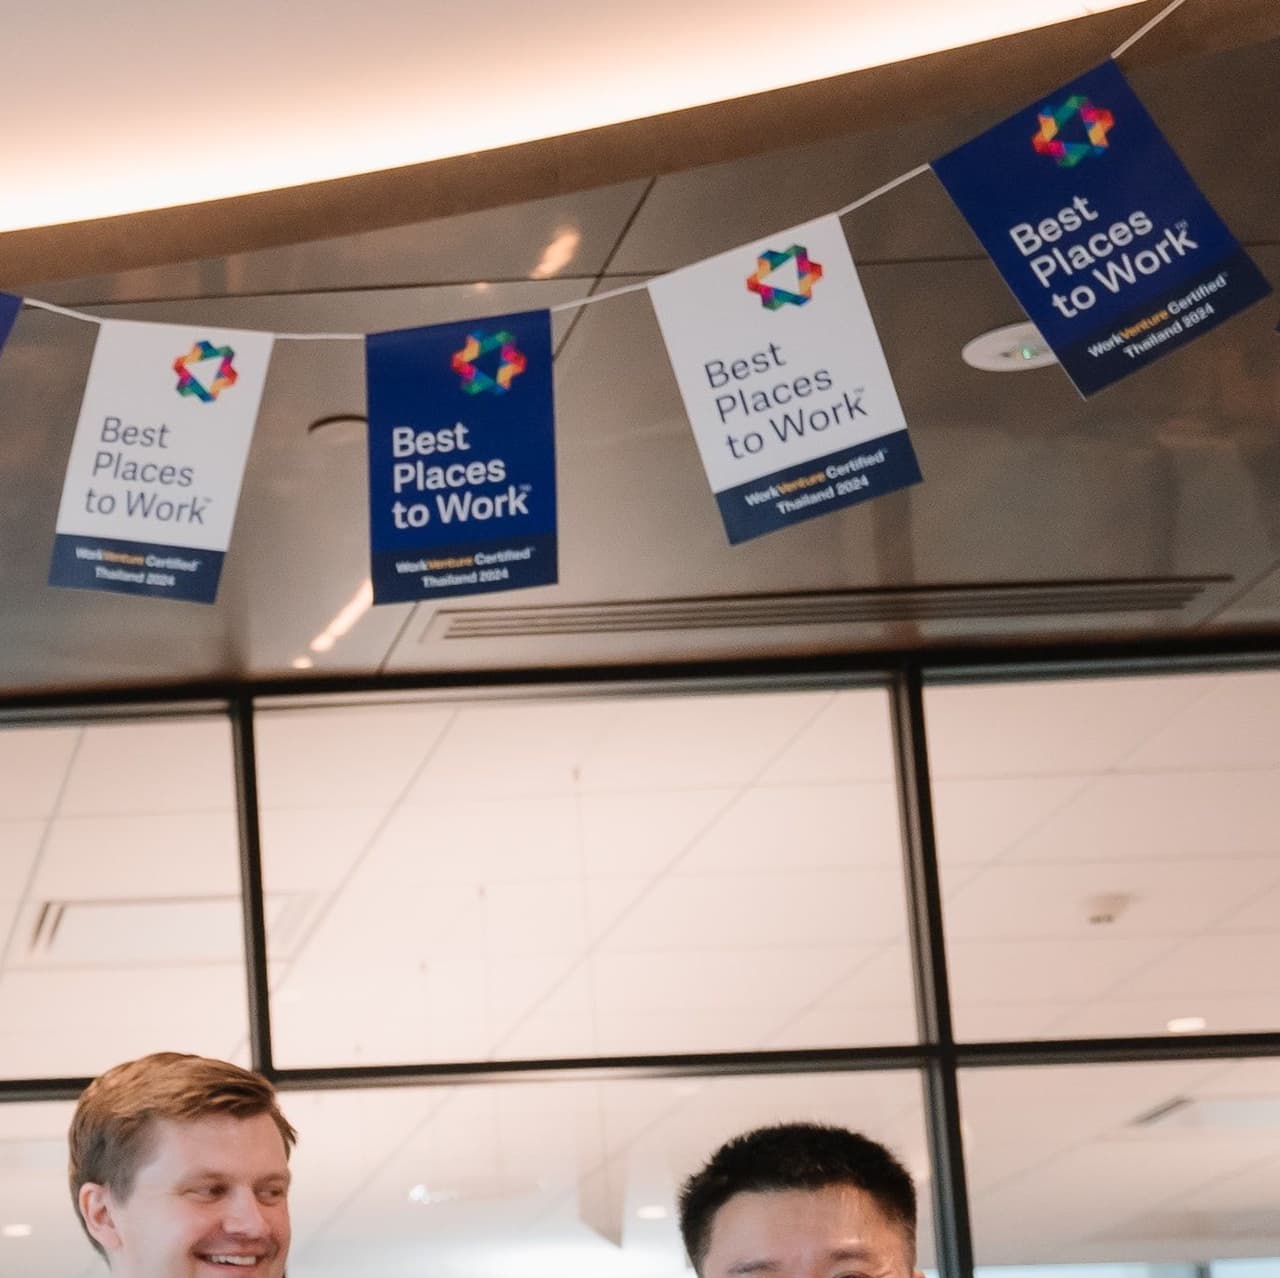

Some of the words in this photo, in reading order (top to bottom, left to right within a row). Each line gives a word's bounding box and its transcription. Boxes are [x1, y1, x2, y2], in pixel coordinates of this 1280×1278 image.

[1009, 196, 1099, 257] Best
[1030, 211, 1153, 288] Places
[1052, 285, 1096, 318] to
[1092, 228, 1198, 293] Work
[1087, 309, 1169, 358] WorkVenture
[1167, 274, 1227, 315] Certified
[1123, 320, 1183, 358] Thailand
[1181, 302, 1215, 329] 2024
[704, 343, 784, 389] Best
[715, 370, 833, 424] Places
[100, 416, 169, 449] Best
[392, 422, 470, 458] Best
[726, 432, 764, 459] to
[769, 392, 868, 443] Work
[92, 451, 193, 488] Places
[393, 459, 506, 493] Places
[744, 472, 825, 507] WorkVenture
[821, 449, 885, 482] Certified
[85, 487, 117, 515] to
[126, 490, 205, 525] Work
[392, 501, 430, 529] to
[436, 485, 529, 524] Work
[775, 486, 833, 515] Thailand
[835, 474, 870, 498] 2024
[94, 565, 145, 584] Thailand
[395, 556, 472, 574] WorkVenture
[470, 547, 532, 567] Certified
[421, 571, 475, 588] Thailand
[477, 567, 509, 584] 2024
